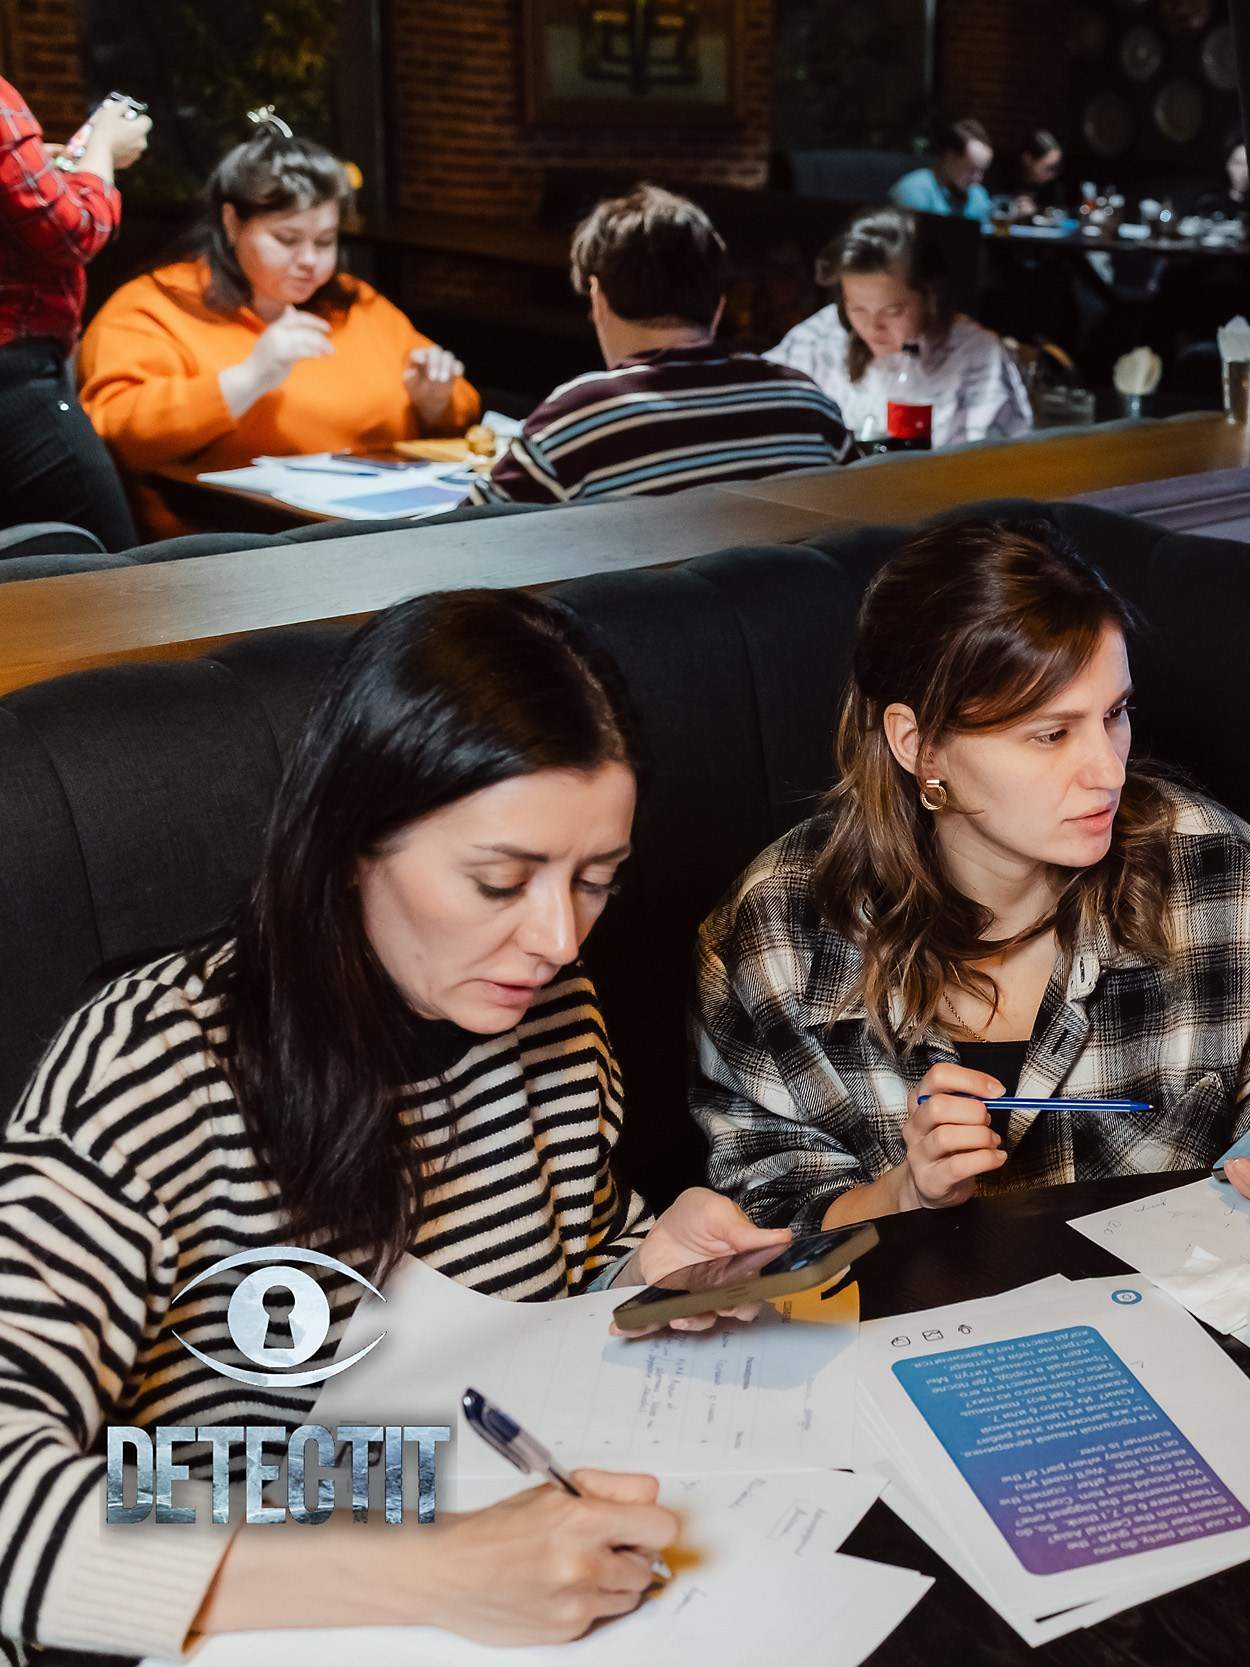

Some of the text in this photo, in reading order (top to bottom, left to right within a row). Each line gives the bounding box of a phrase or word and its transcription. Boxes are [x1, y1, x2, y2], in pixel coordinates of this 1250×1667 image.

[1053, 1329, 1088, 1341] когда
[1017, 1338, 1052, 1347] часть
[1037, 1337, 1094, 1353] встретим
[986, 1344, 1014, 1354] лета
[1007, 1349, 1035, 1360] тебя
[991, 1354, 1058, 1372] восточный
[1046, 1354, 1108, 1371] Приезжай
[1085, 1362, 1116, 1372] Тебе
[1050, 1368, 1083, 1379] стоит
[925, 1375, 949, 1385] Мы
[971, 1376, 992, 1385] где
[982, 1375, 1047, 1392] навестить
[931, 1381, 969, 1393] после
[965, 1369, 1121, 1408] самого большого из них?
[1099, 1386, 1134, 1400] Азии?
[1049, 1390, 1072, 1399] Так
[1075, 1395, 1093, 1403] Их
[959, 1400, 1020, 1416] помнишь
[1039, 1399, 1074, 1411] было
[1067, 1407, 1083, 1415] из
[1002, 1408, 1027, 1419] или
[1138, 1412, 1157, 1421] На
[976, 1404, 1150, 1444] ты же запомнил этих ребят
[980, 1411, 1066, 1434] Центральной
[1079, 1417, 1137, 1434] прошлой
[1035, 1429, 1077, 1443] нашей
[1122, 1430, 1171, 1446] summer
[1107, 1441, 1120, 1449] is
[1000, 1439, 1179, 1482] on Thursday when part of the
[1140, 1448, 1186, 1463] eastern
[1173, 1457, 1195, 1467] the
[1107, 1468, 1145, 1481] where
[1177, 1467, 1204, 1477] You
[1014, 1479, 1039, 1491] you
[1040, 1473, 1073, 1486] meet
[1076, 1477, 1105, 1489] after
[1133, 1472, 1176, 1488] should
[1022, 1485, 1066, 1500] comes
[1105, 1482, 1132, 1494] visit
[1181, 1486, 1219, 1499] There
[998, 1495, 1021, 1505] the
[1015, 1474, 1211, 1527] you remember the biggest one?
[1034, 1495, 1073, 1509] Come
[1148, 1494, 1180, 1507] were
[1017, 1504, 1033, 1513] to
[1122, 1504, 1136, 1513] or
[1047, 1495, 1227, 1544] Stans from the Central Asia?
[1171, 1505, 1234, 1525] remember
[1227, 1514, 1241, 1524] At
[1131, 1520, 1169, 1534] these
[1177, 1523, 1204, 1536] last
[1204, 1518, 1225, 1529] our
[1014, 1527, 1033, 1537] do
[1097, 1528, 1130, 1542] guys
[1066, 1538, 1089, 1549] the
[1093, 1542, 1119, 1555] you
[1119, 1539, 1138, 1549] do
